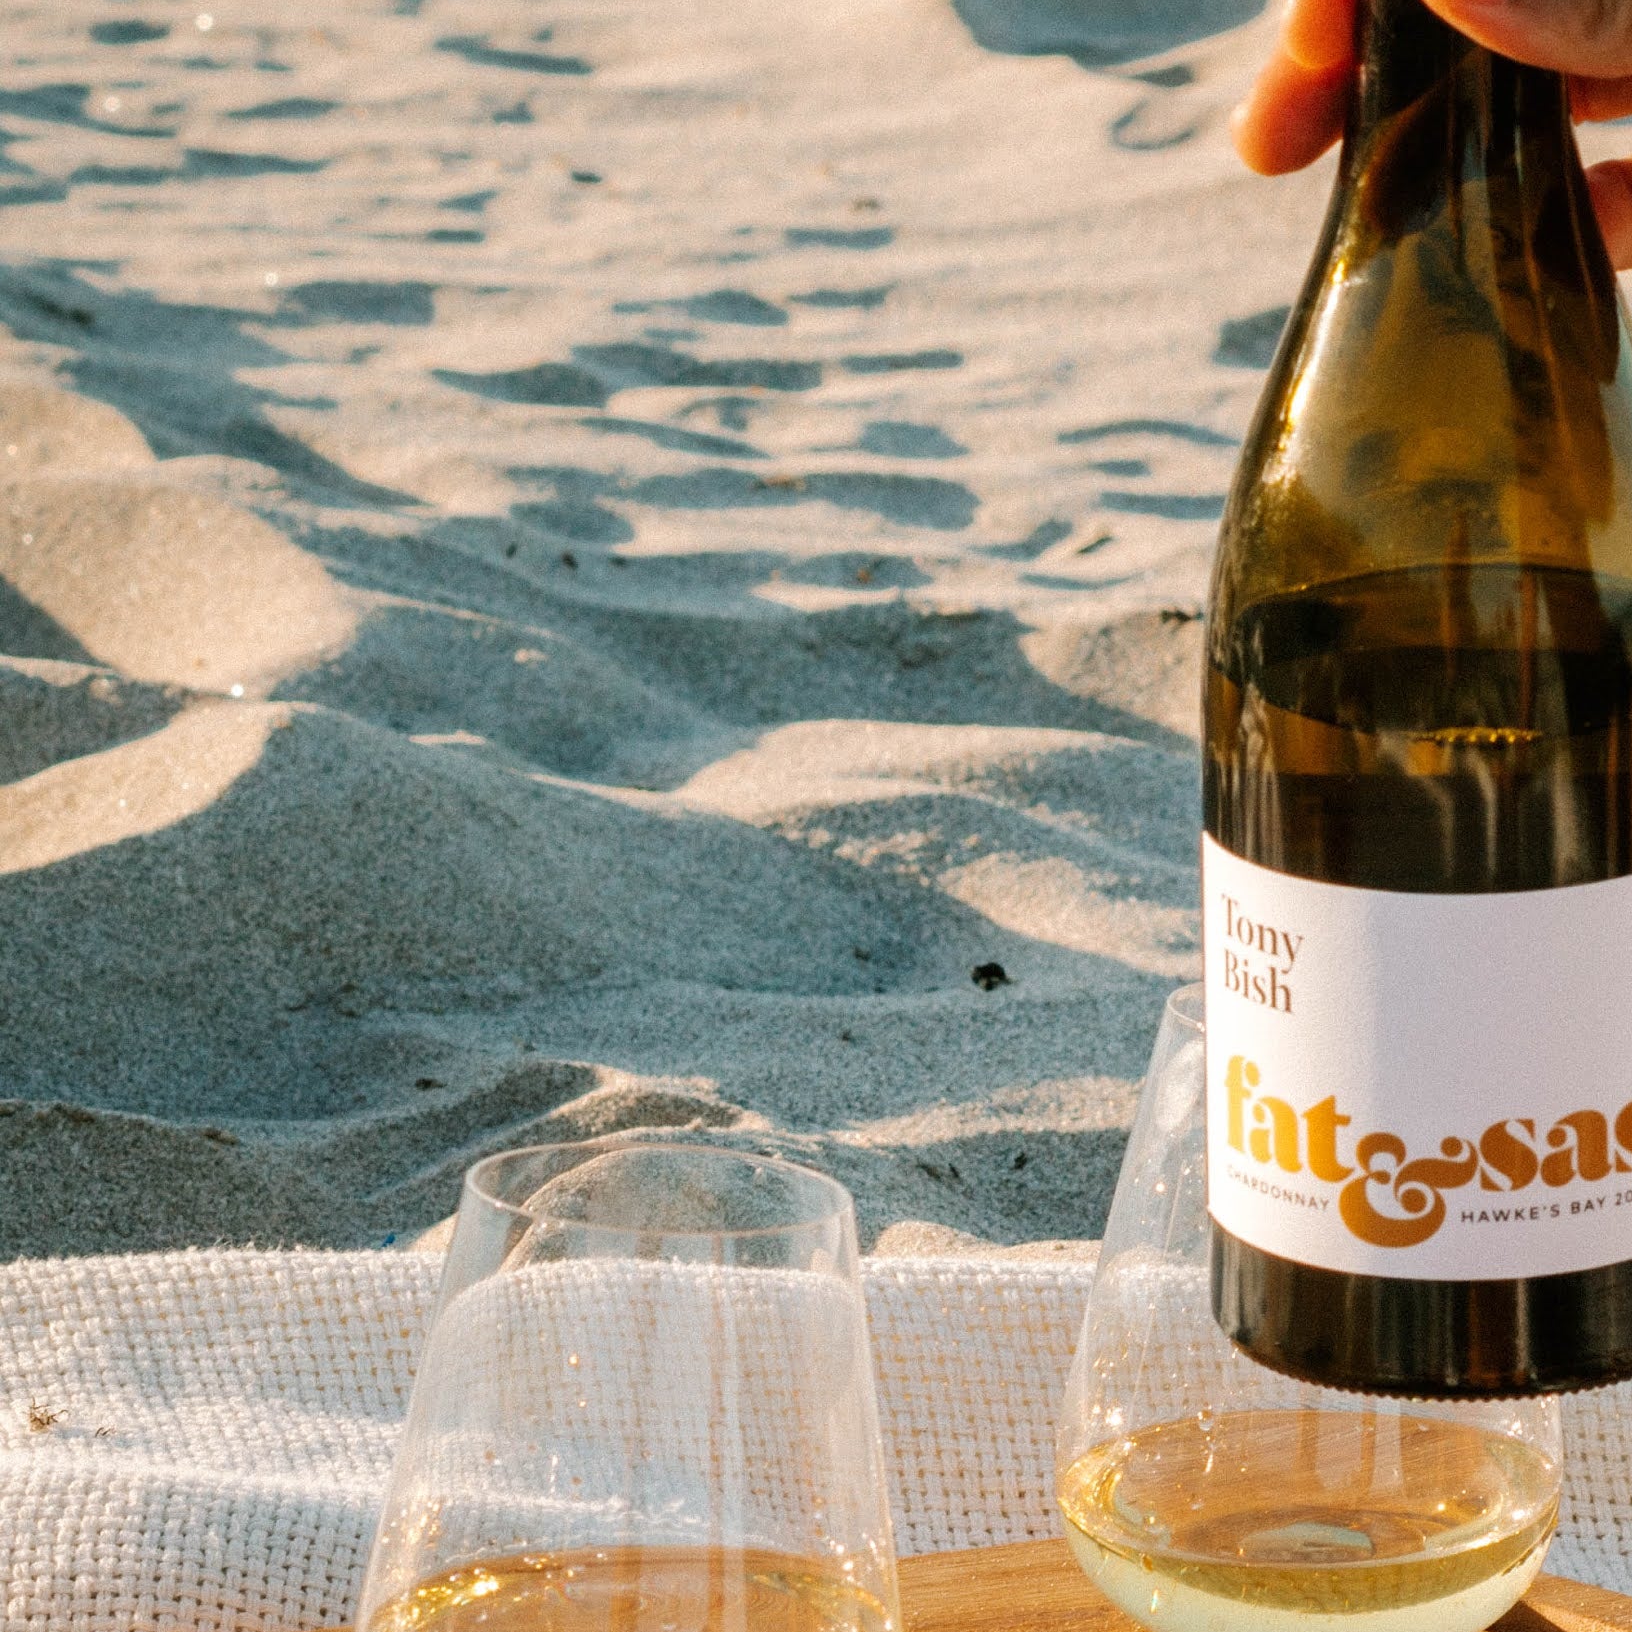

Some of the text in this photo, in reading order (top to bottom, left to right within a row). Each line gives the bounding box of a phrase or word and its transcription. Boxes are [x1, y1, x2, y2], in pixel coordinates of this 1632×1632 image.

[1221, 893, 1304, 974] Tony
[1224, 948, 1293, 1013] Bish
[1227, 1164, 1329, 1210] CHARDONNAY
[1461, 1203, 1560, 1223] HAWKE'S
[1570, 1196, 1606, 1215] BAY
